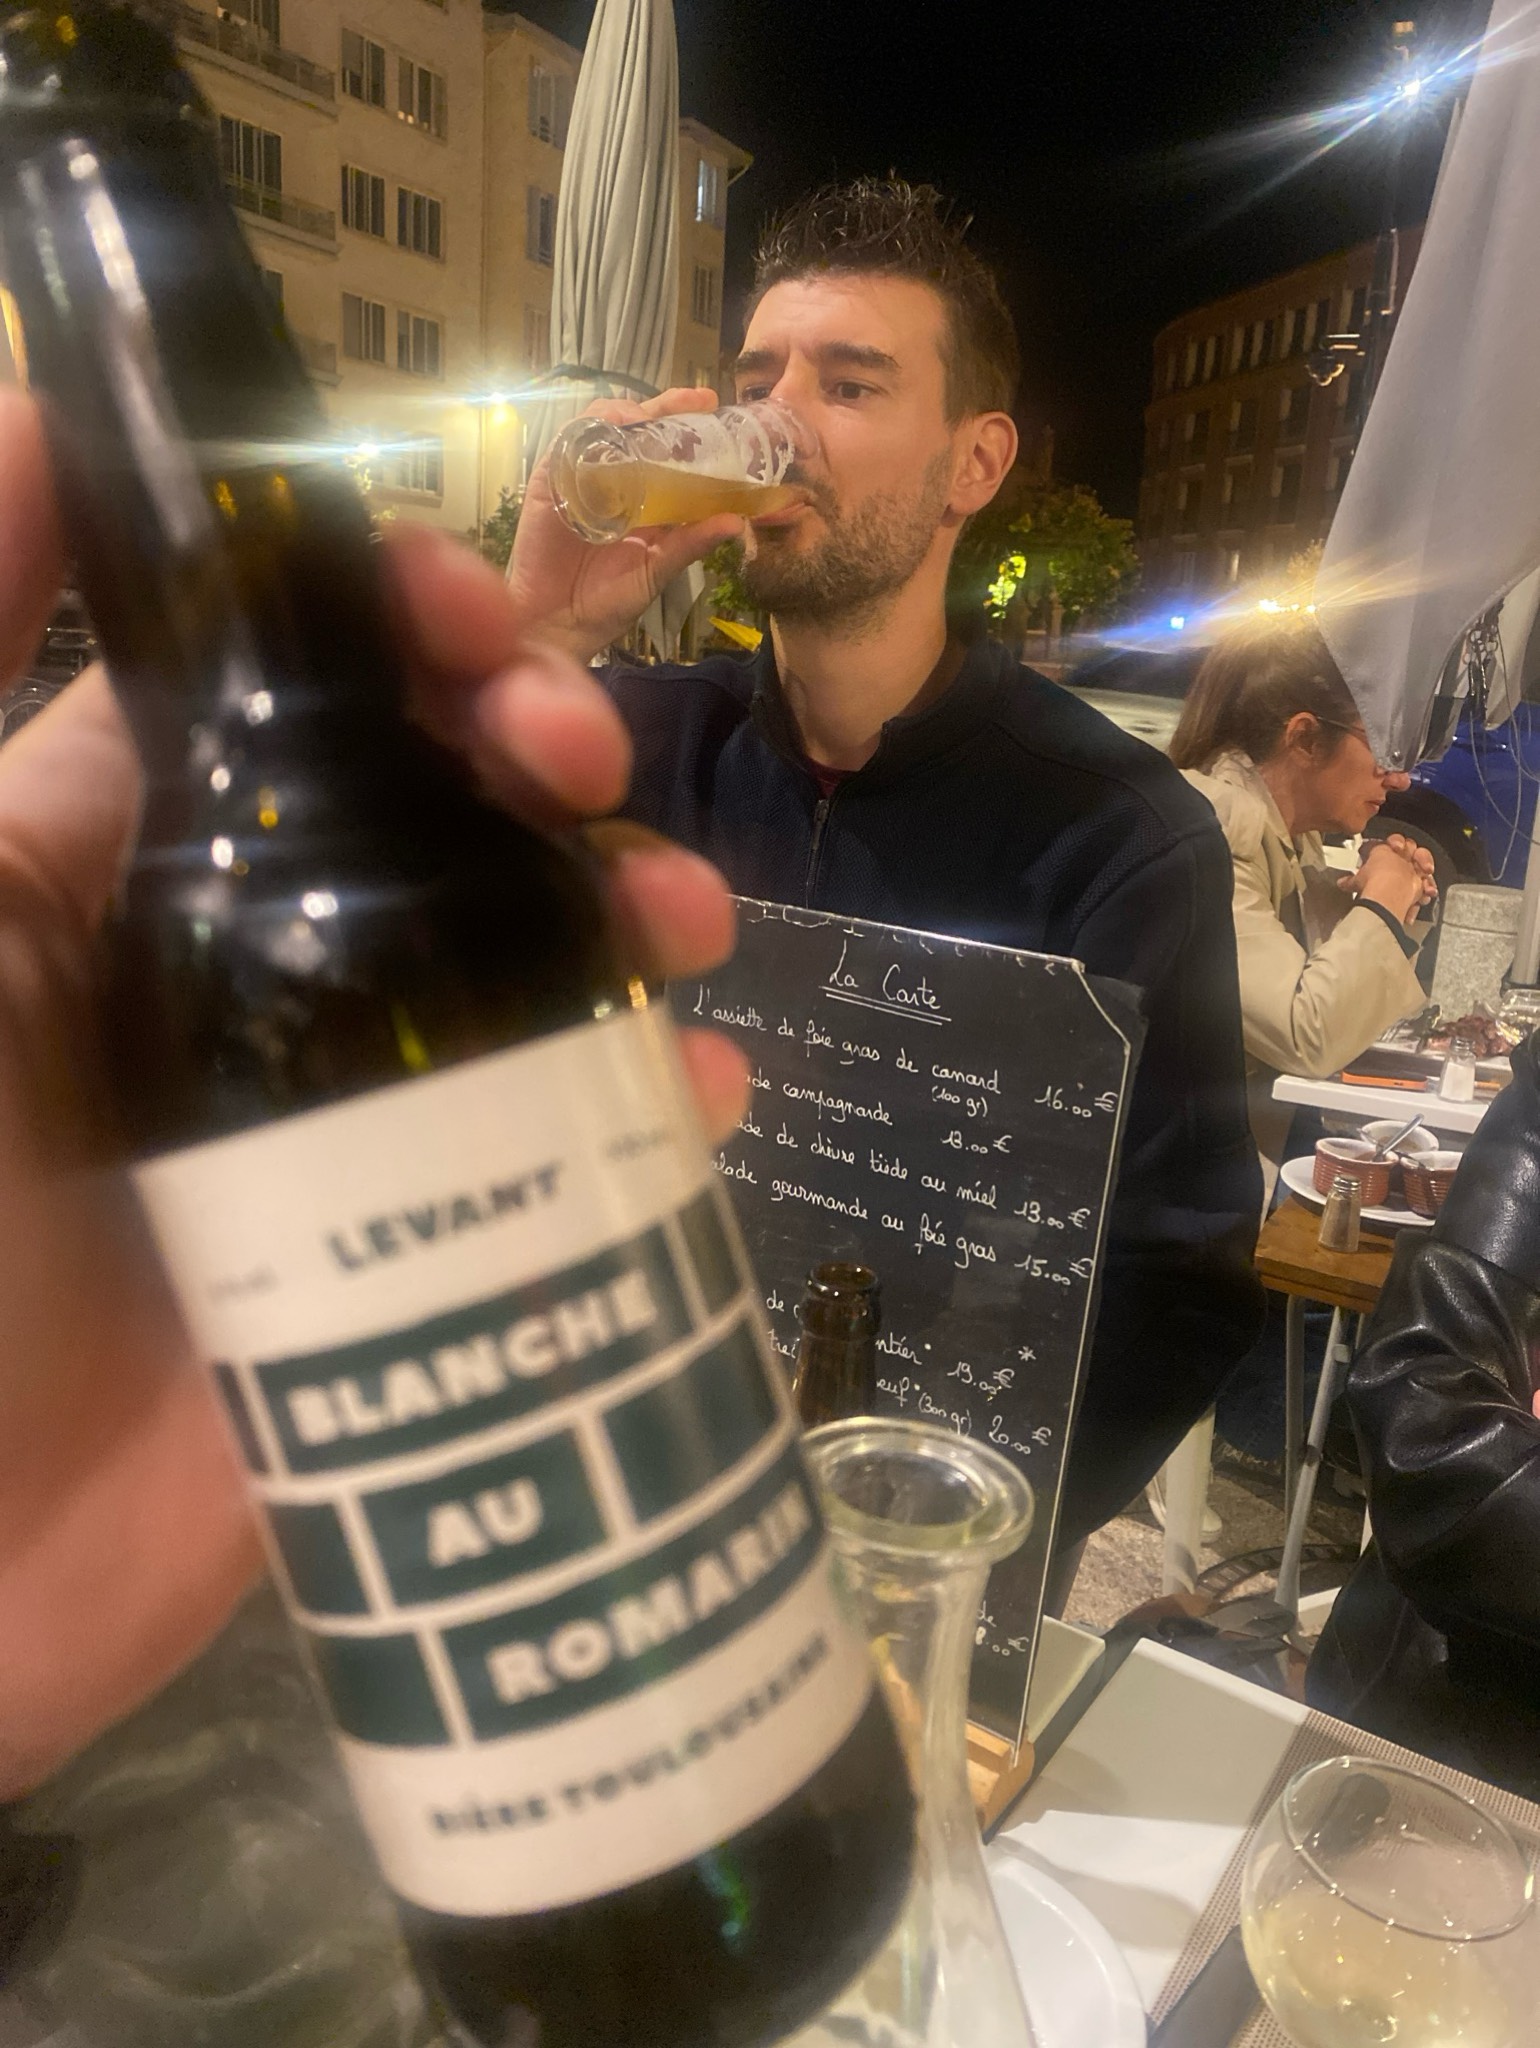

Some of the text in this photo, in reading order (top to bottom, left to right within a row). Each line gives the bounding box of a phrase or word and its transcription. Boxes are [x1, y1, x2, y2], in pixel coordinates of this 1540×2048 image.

[828, 938, 941, 1010] La Carte
[777, 1017, 796, 1038] de
[803, 1019, 835, 1058] foie
[839, 1040, 881, 1065] gras
[896, 1047, 919, 1073] de
[931, 1063, 1001, 1095] canard
[782, 1082, 893, 1127] campagnarde
[736, 1111, 764, 1138] ade
[776, 1122, 799, 1149] de
[810, 1132, 856, 1165] chèvre
[921, 1174, 947, 1193] au
[956, 1180, 997, 1210] miel
[324, 1158, 565, 1274] LEVANT
[711, 1151, 758, 1185] alade
[770, 1179, 869, 1220] gourmande
[880, 1213, 904, 1232] au
[914, 1212, 947, 1256] foie
[954, 1235, 997, 1269] gras
[285, 1266, 660, 1448] BLANCHE
[875, 1331, 923, 1367] ntier
[876, 1375, 910, 1408] euf
[426, 1476, 545, 1570] AU
[486, 1479, 814, 1706] ROMARIN
